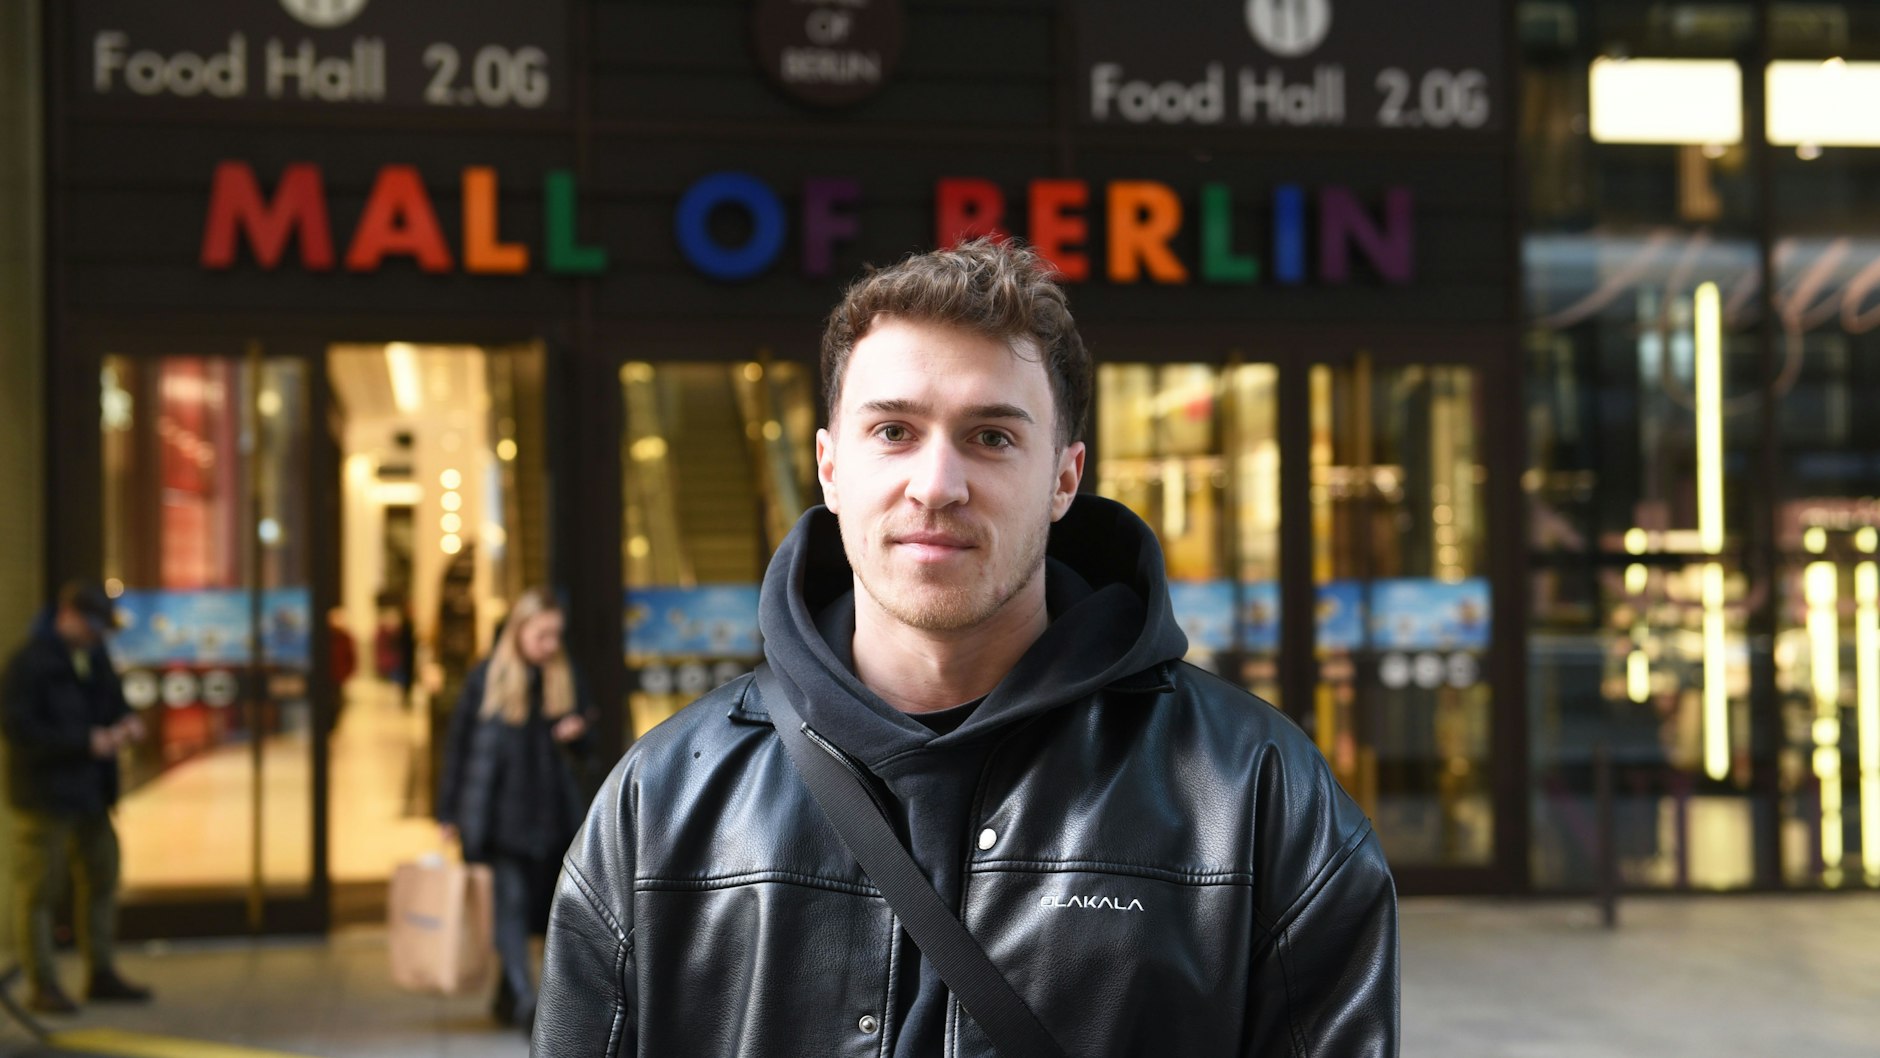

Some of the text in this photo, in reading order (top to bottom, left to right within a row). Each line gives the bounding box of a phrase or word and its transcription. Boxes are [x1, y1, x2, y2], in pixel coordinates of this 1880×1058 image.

[94, 31, 549, 108] Food Hall 2.0G
[780, 46, 883, 84] BERLIN
[1091, 61, 1490, 129] Food Hall 2.0G
[201, 160, 1416, 284] MALL OF BERLIN
[1040, 895, 1145, 912] OLAKALA
